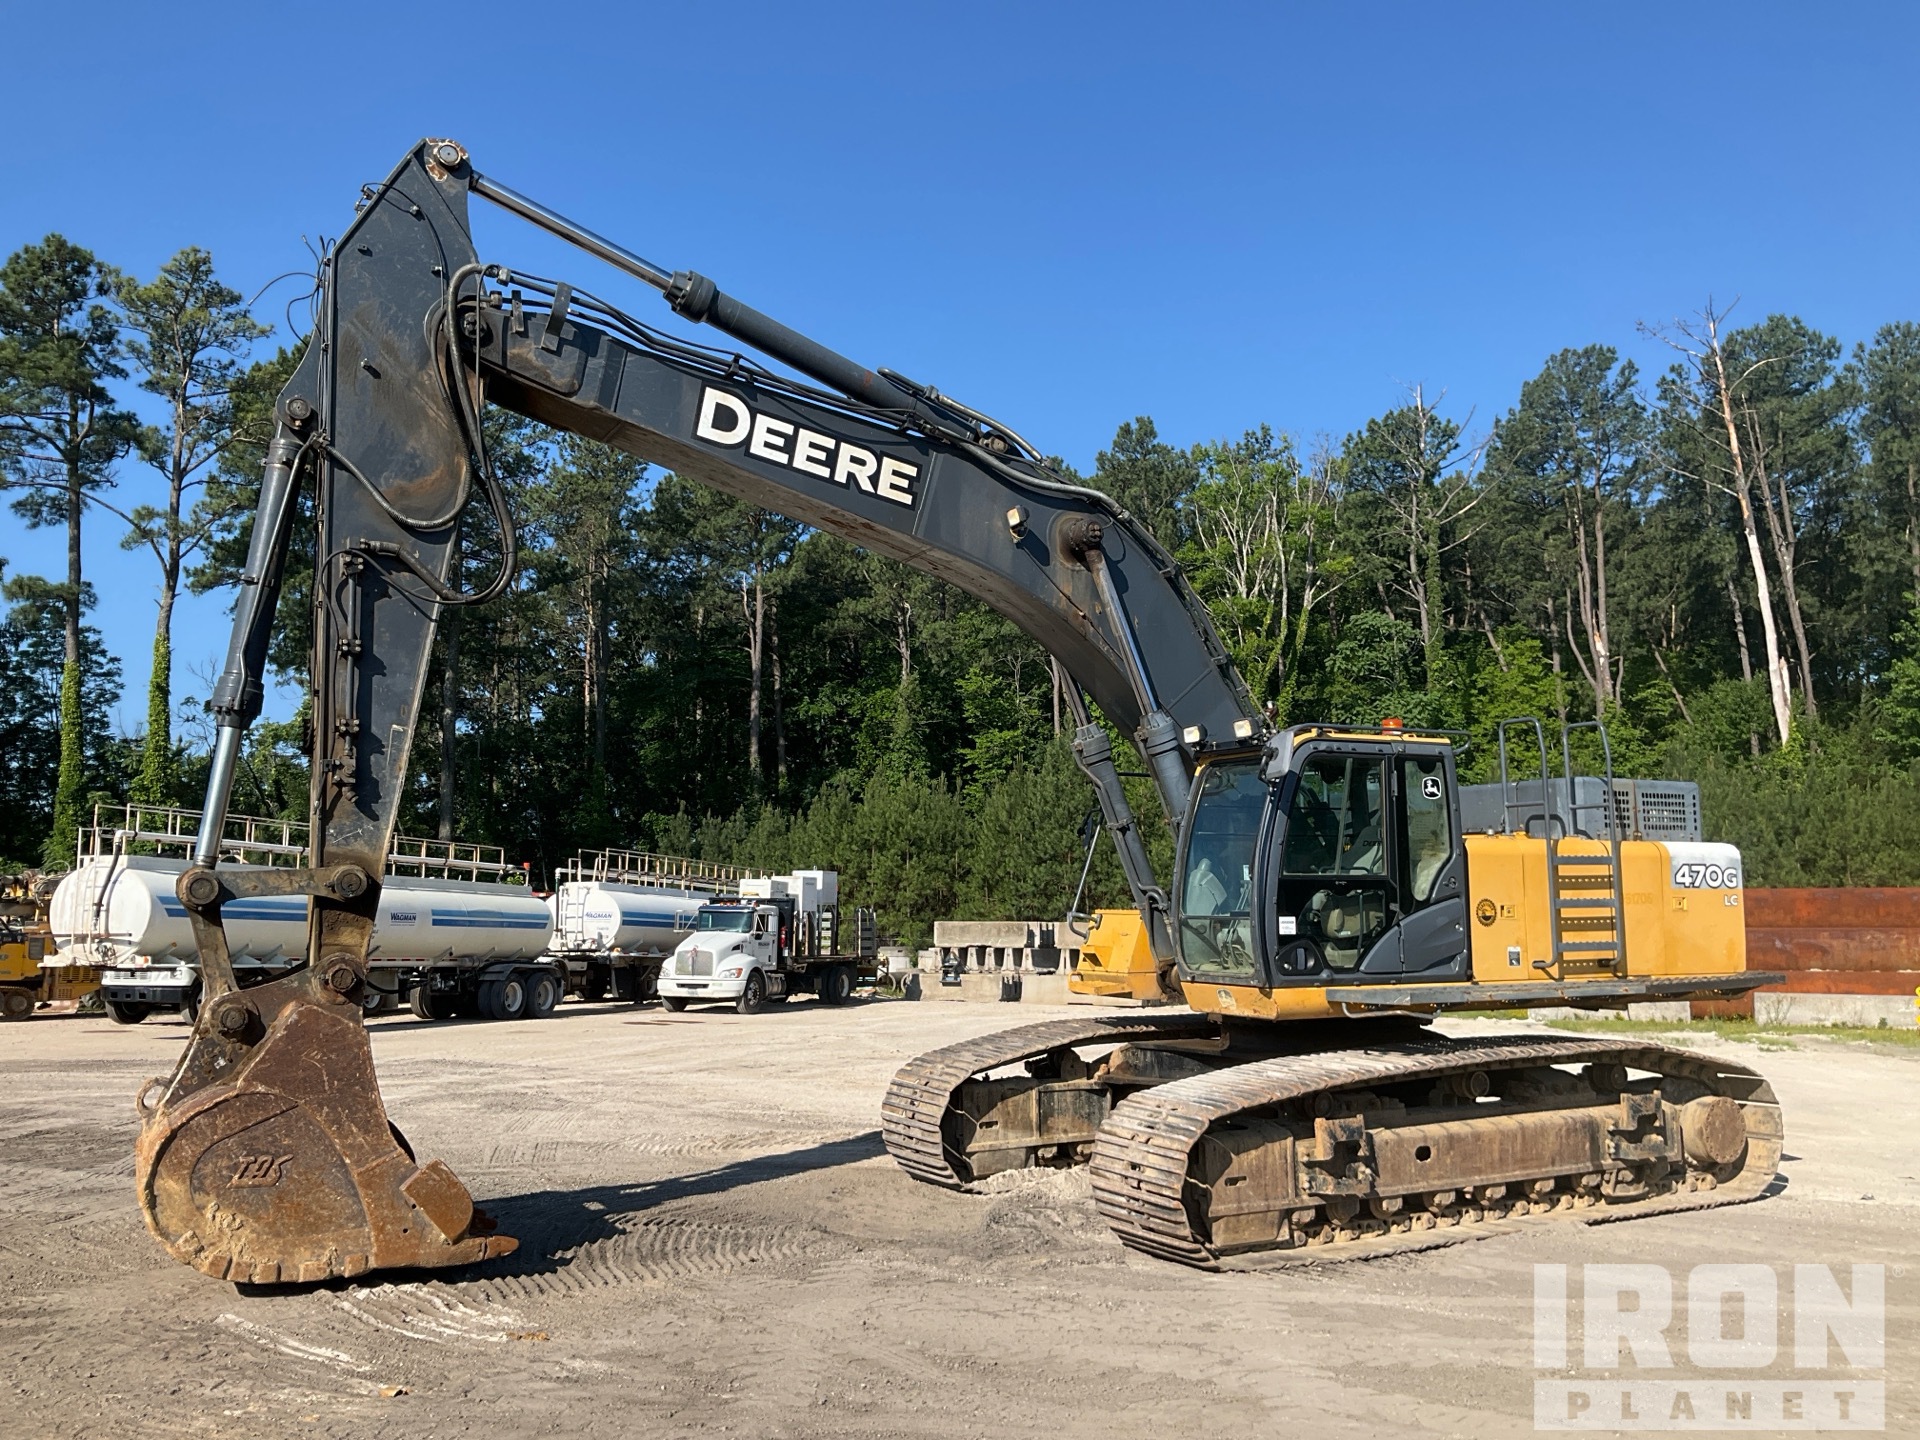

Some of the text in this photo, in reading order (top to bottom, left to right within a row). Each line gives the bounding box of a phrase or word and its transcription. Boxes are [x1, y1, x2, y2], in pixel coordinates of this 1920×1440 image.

[696, 387, 918, 505] DEERE
[1675, 863, 1737, 888] 470G
[1724, 894, 1738, 906] LC
[390, 911, 417, 921] WAGMAN
